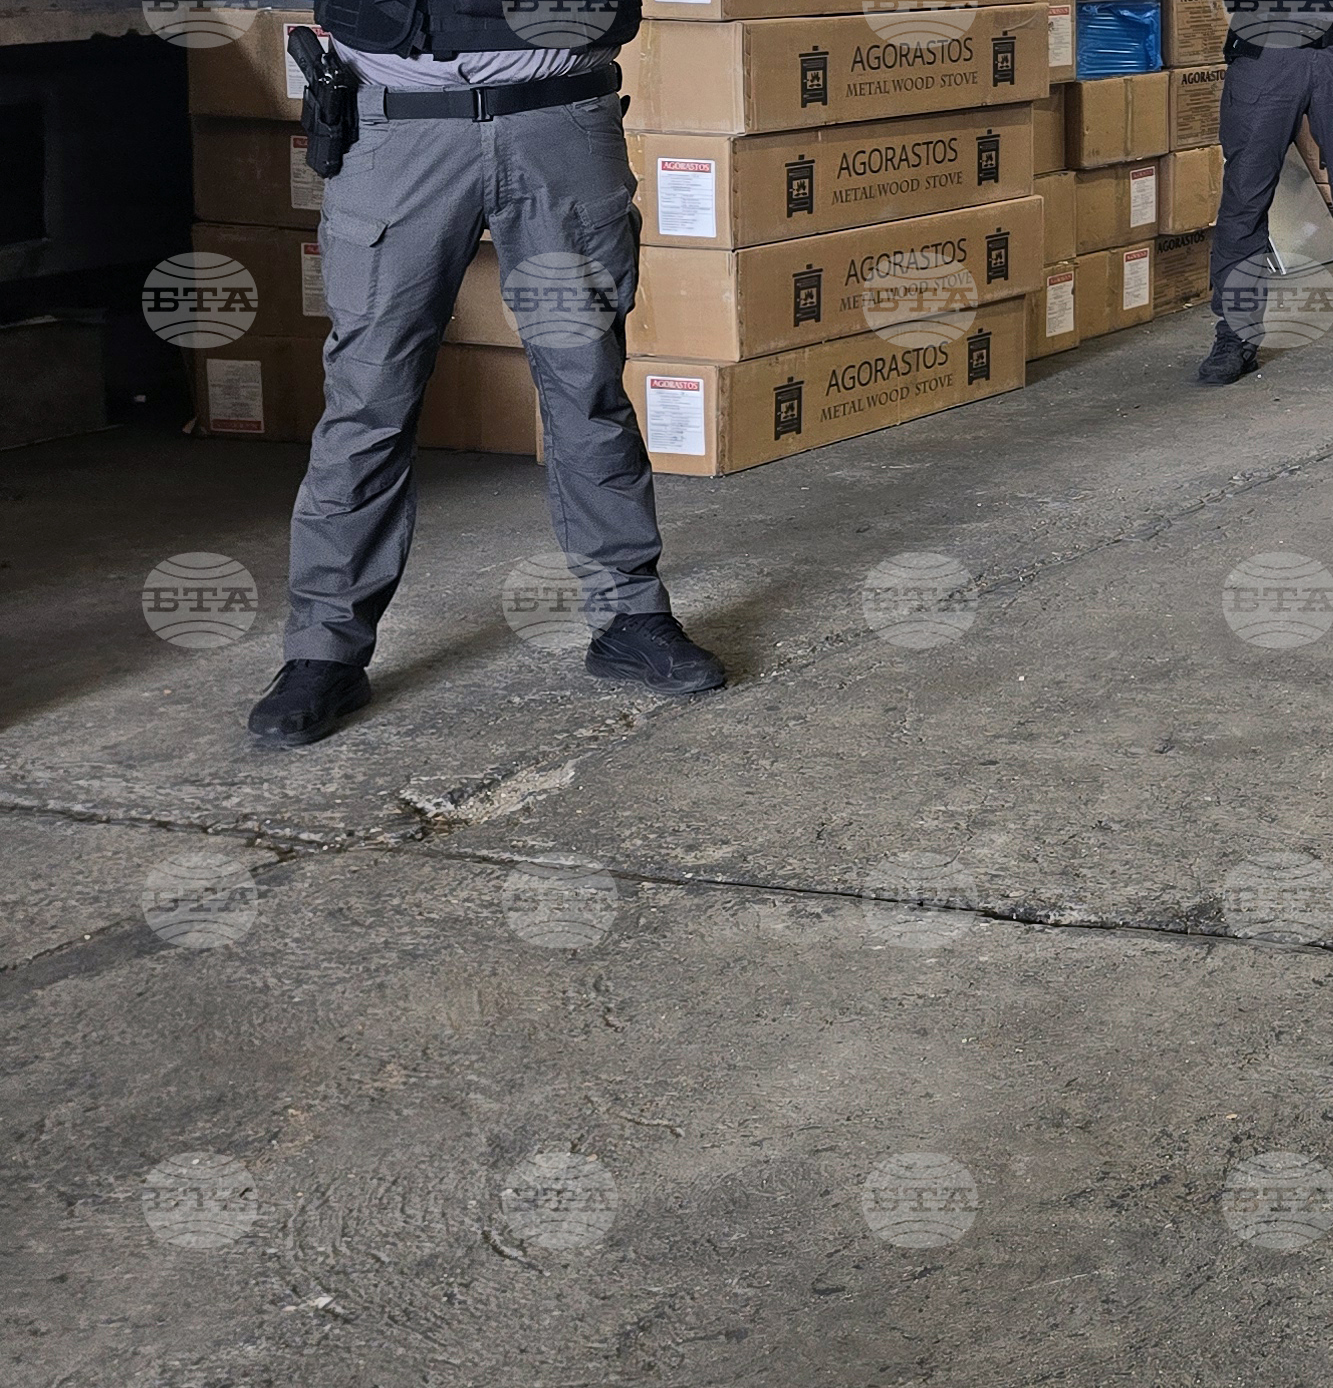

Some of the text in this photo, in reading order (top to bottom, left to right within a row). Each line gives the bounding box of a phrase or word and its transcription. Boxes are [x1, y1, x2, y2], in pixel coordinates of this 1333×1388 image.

[851, 37, 974, 72] AGORASTOS
[845, 71, 978, 98] METAL WOOD STOVE
[661, 161, 710, 172] AGORASTOS
[837, 137, 958, 179] AGORASTOS
[831, 171, 963, 206] METAL WOOD STOVE
[1157, 232, 1206, 254] AGORASTOS
[845, 238, 967, 286] AGORASTOS
[839, 271, 972, 312] METAL WOOD STOVE
[651, 379, 699, 391] AGORASTOS
[825, 341, 949, 396] AGORASTOS
[820, 373, 953, 423] METAL WOOD STOVE
